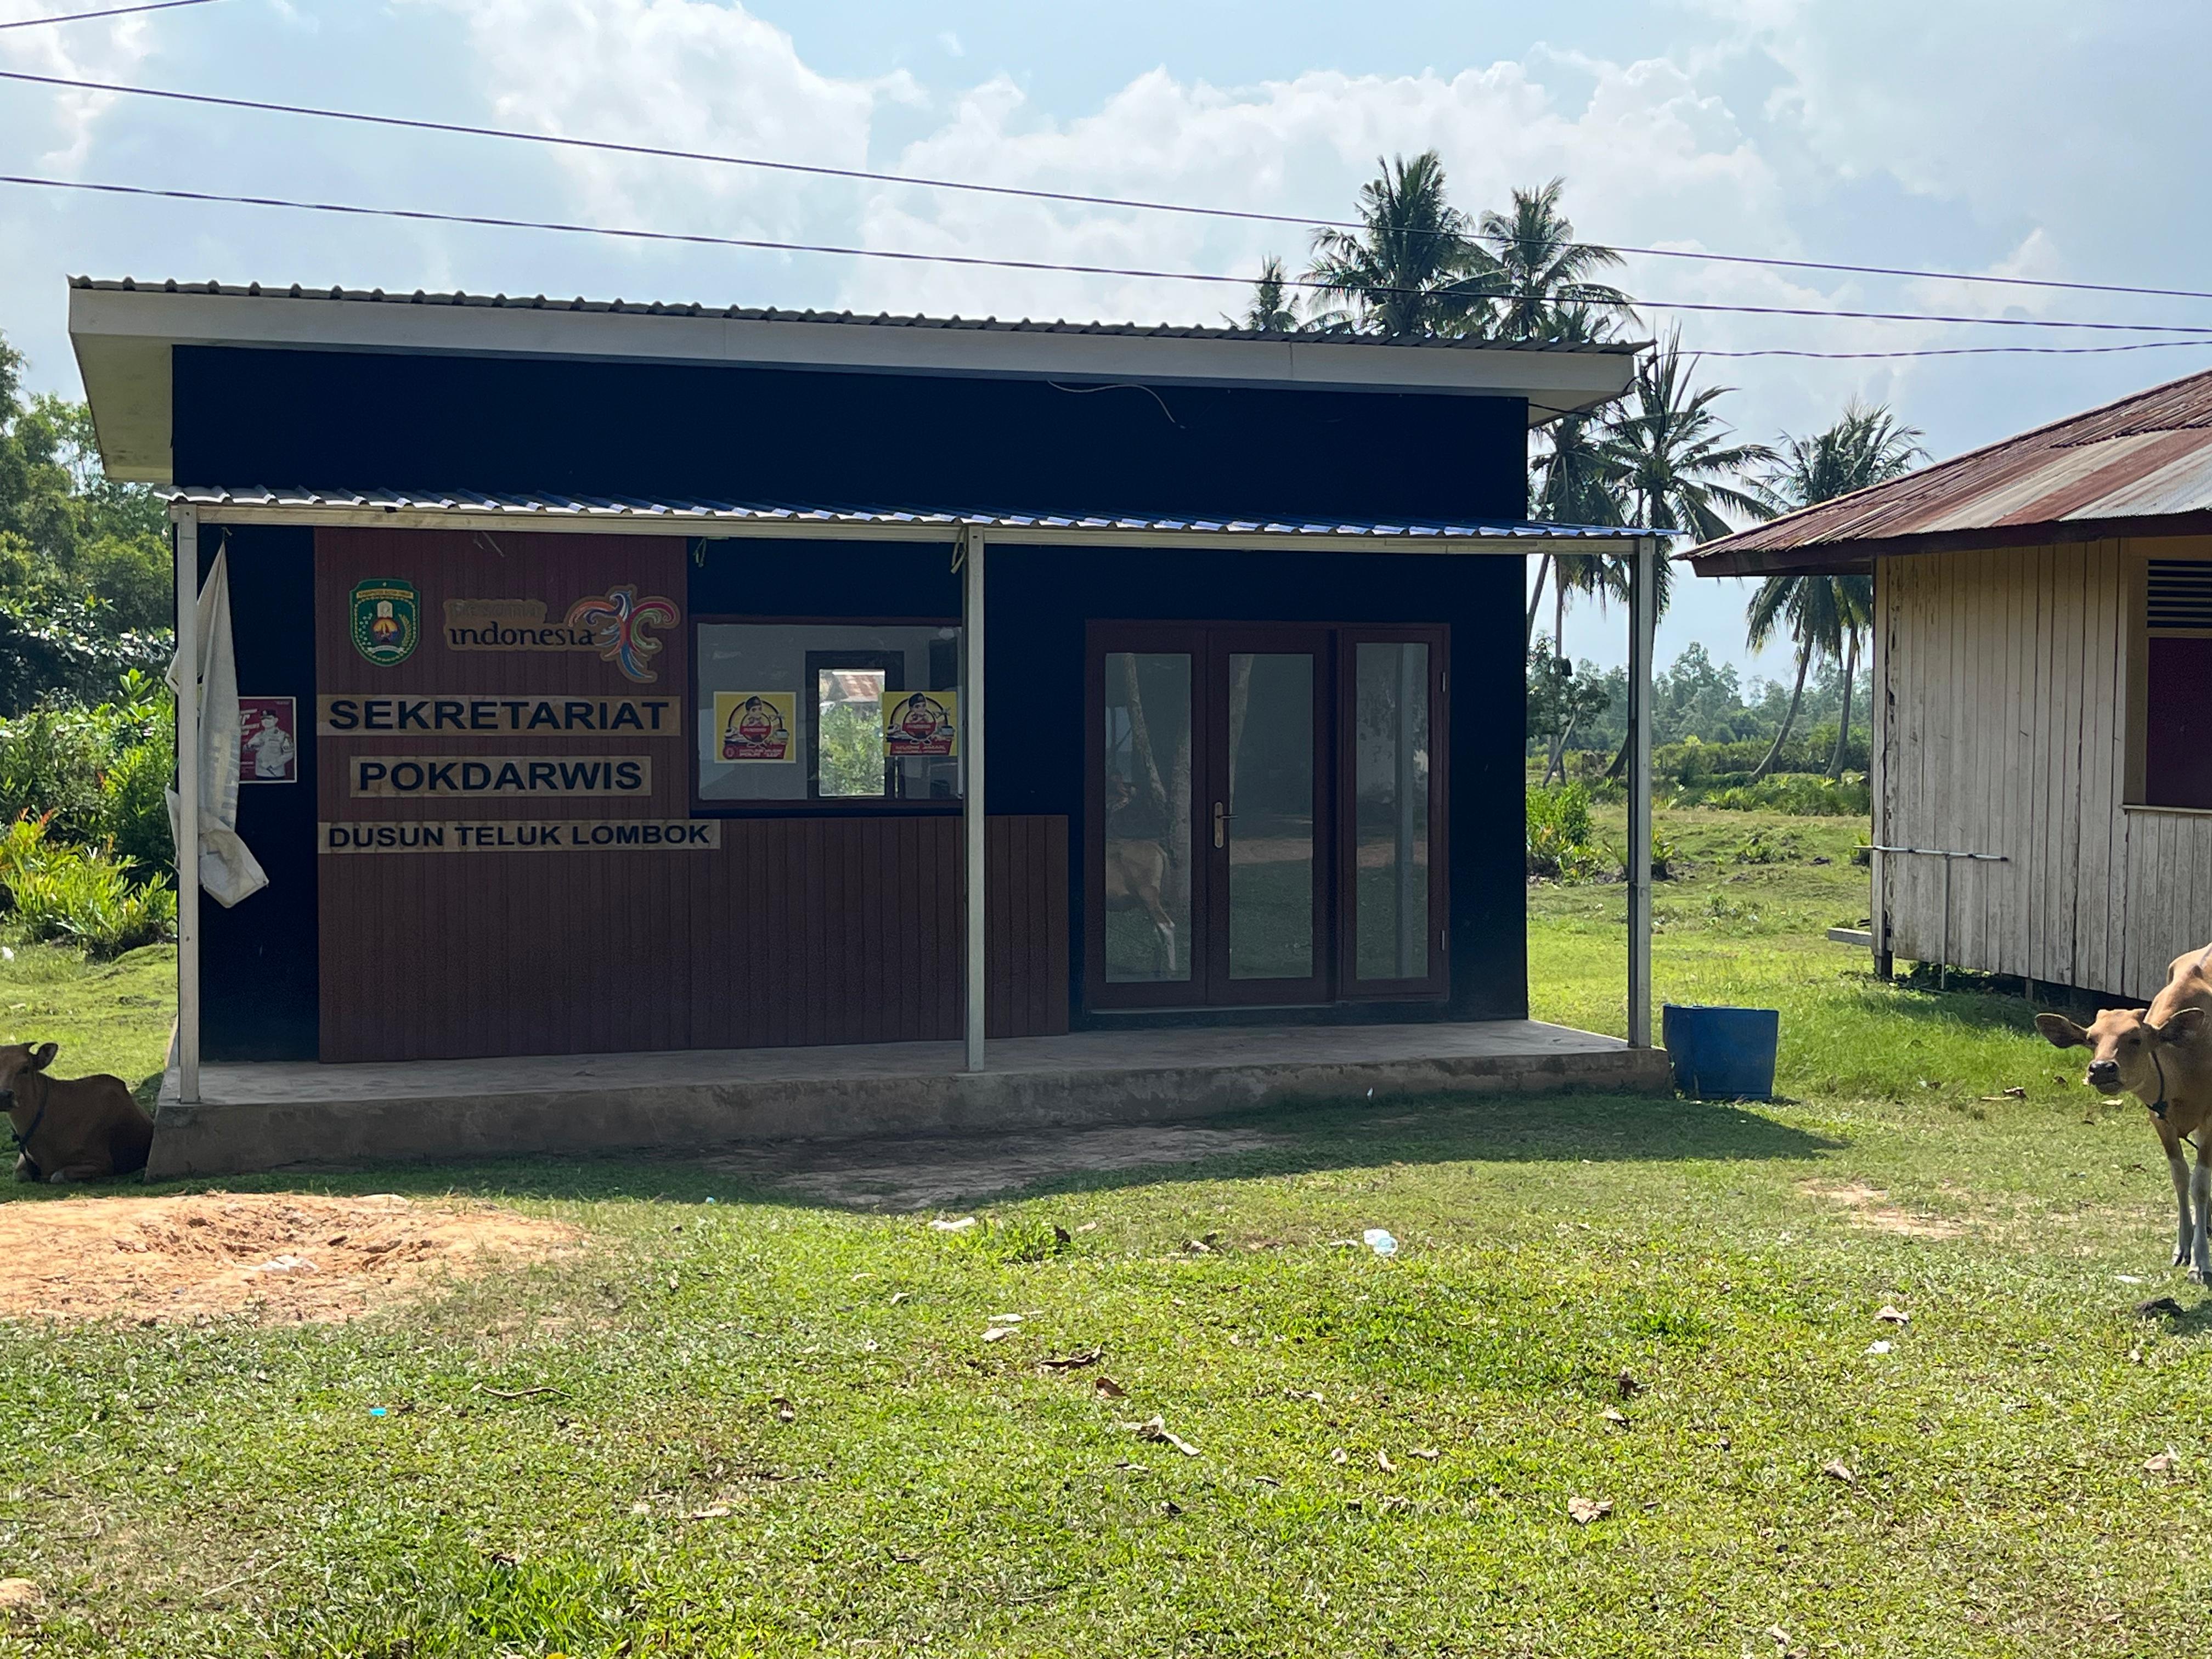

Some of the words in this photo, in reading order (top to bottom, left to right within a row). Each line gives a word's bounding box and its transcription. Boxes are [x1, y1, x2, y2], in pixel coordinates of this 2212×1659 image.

[449, 622, 597, 646] indonesia
[329, 701, 669, 730] SEKRETARIAT
[359, 762, 642, 791] POKDARWIS
[329, 827, 443, 847] DUSUN
[455, 826, 561, 845] TELUK
[572, 825, 709, 844] LOMBOK
